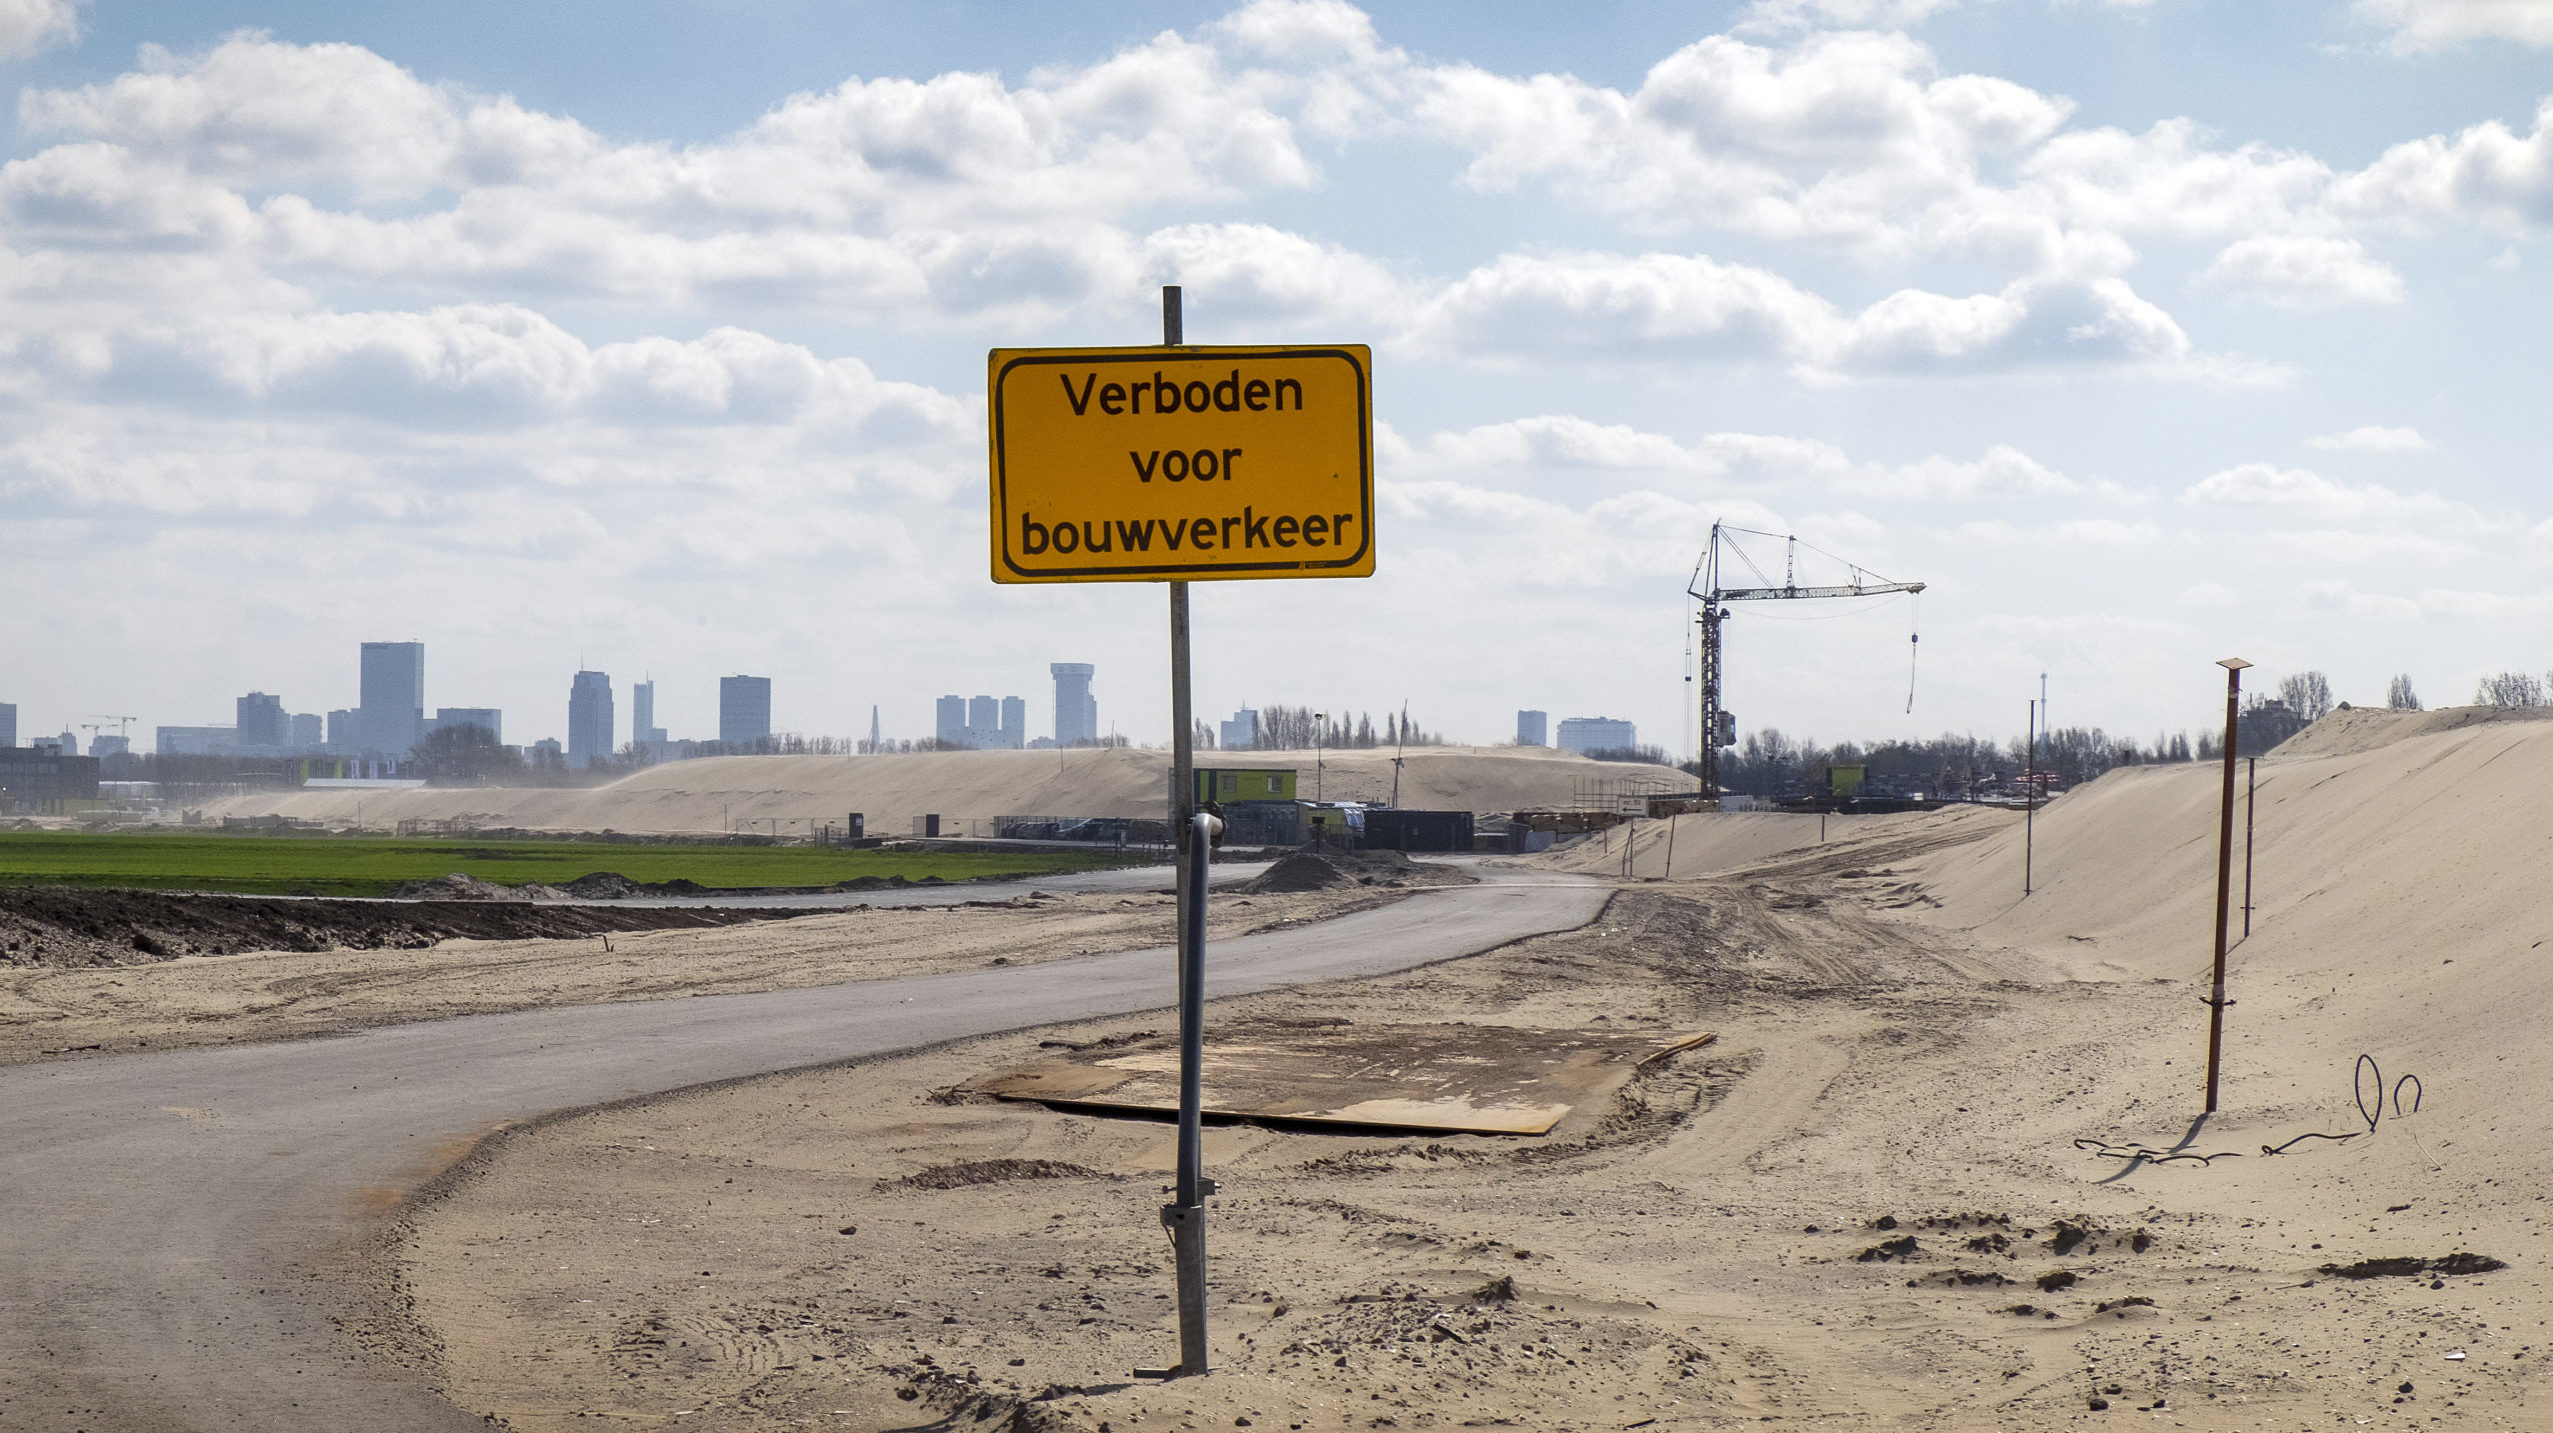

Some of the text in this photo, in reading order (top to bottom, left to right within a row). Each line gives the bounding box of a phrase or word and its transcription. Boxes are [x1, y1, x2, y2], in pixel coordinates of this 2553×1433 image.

[1060, 369, 1303, 416] Verboden
[1129, 448, 1243, 483] voor
[1022, 505, 1353, 555] bouwverkeer
